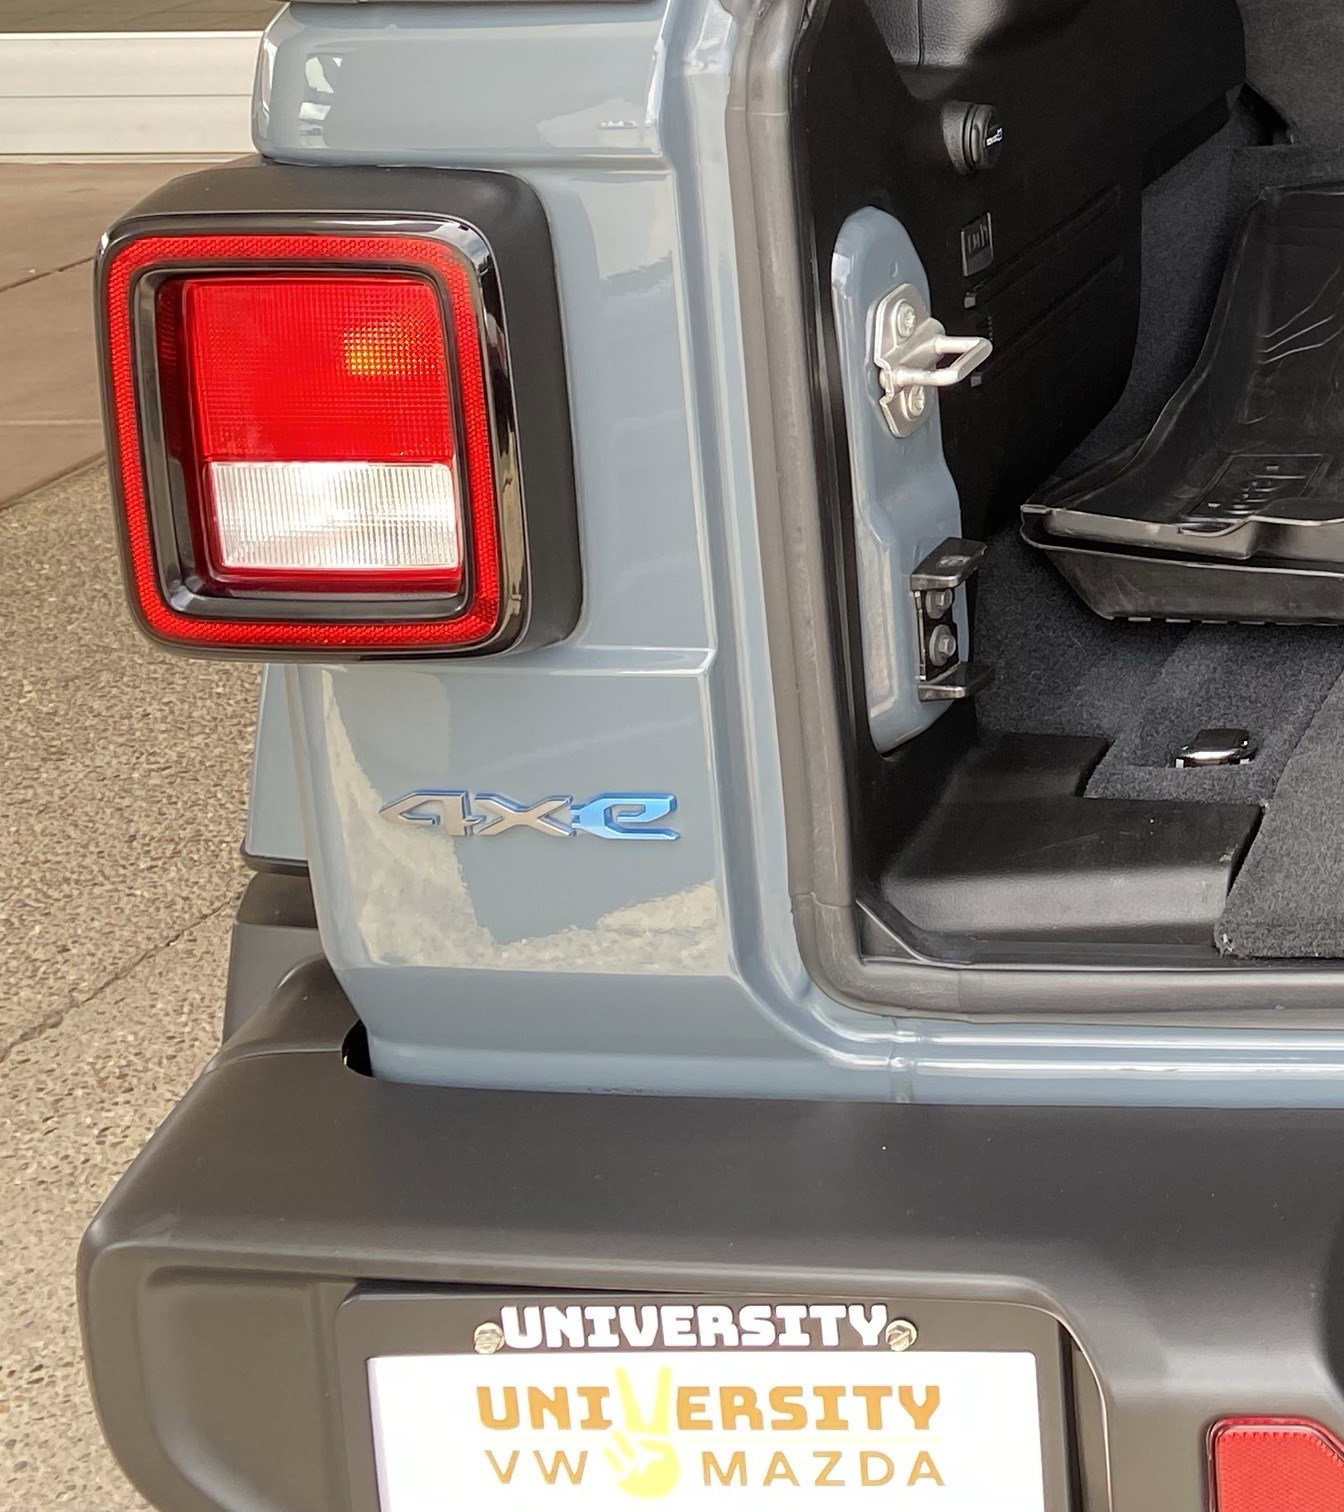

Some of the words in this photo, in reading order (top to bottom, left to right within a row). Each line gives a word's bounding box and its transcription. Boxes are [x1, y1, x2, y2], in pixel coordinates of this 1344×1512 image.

[500, 1304, 889, 1350] UNIVERSITY
[477, 1374, 942, 1433] UNIVERSITY
[485, 1450, 589, 1486] VW
[701, 1450, 946, 1487] MAZDA
